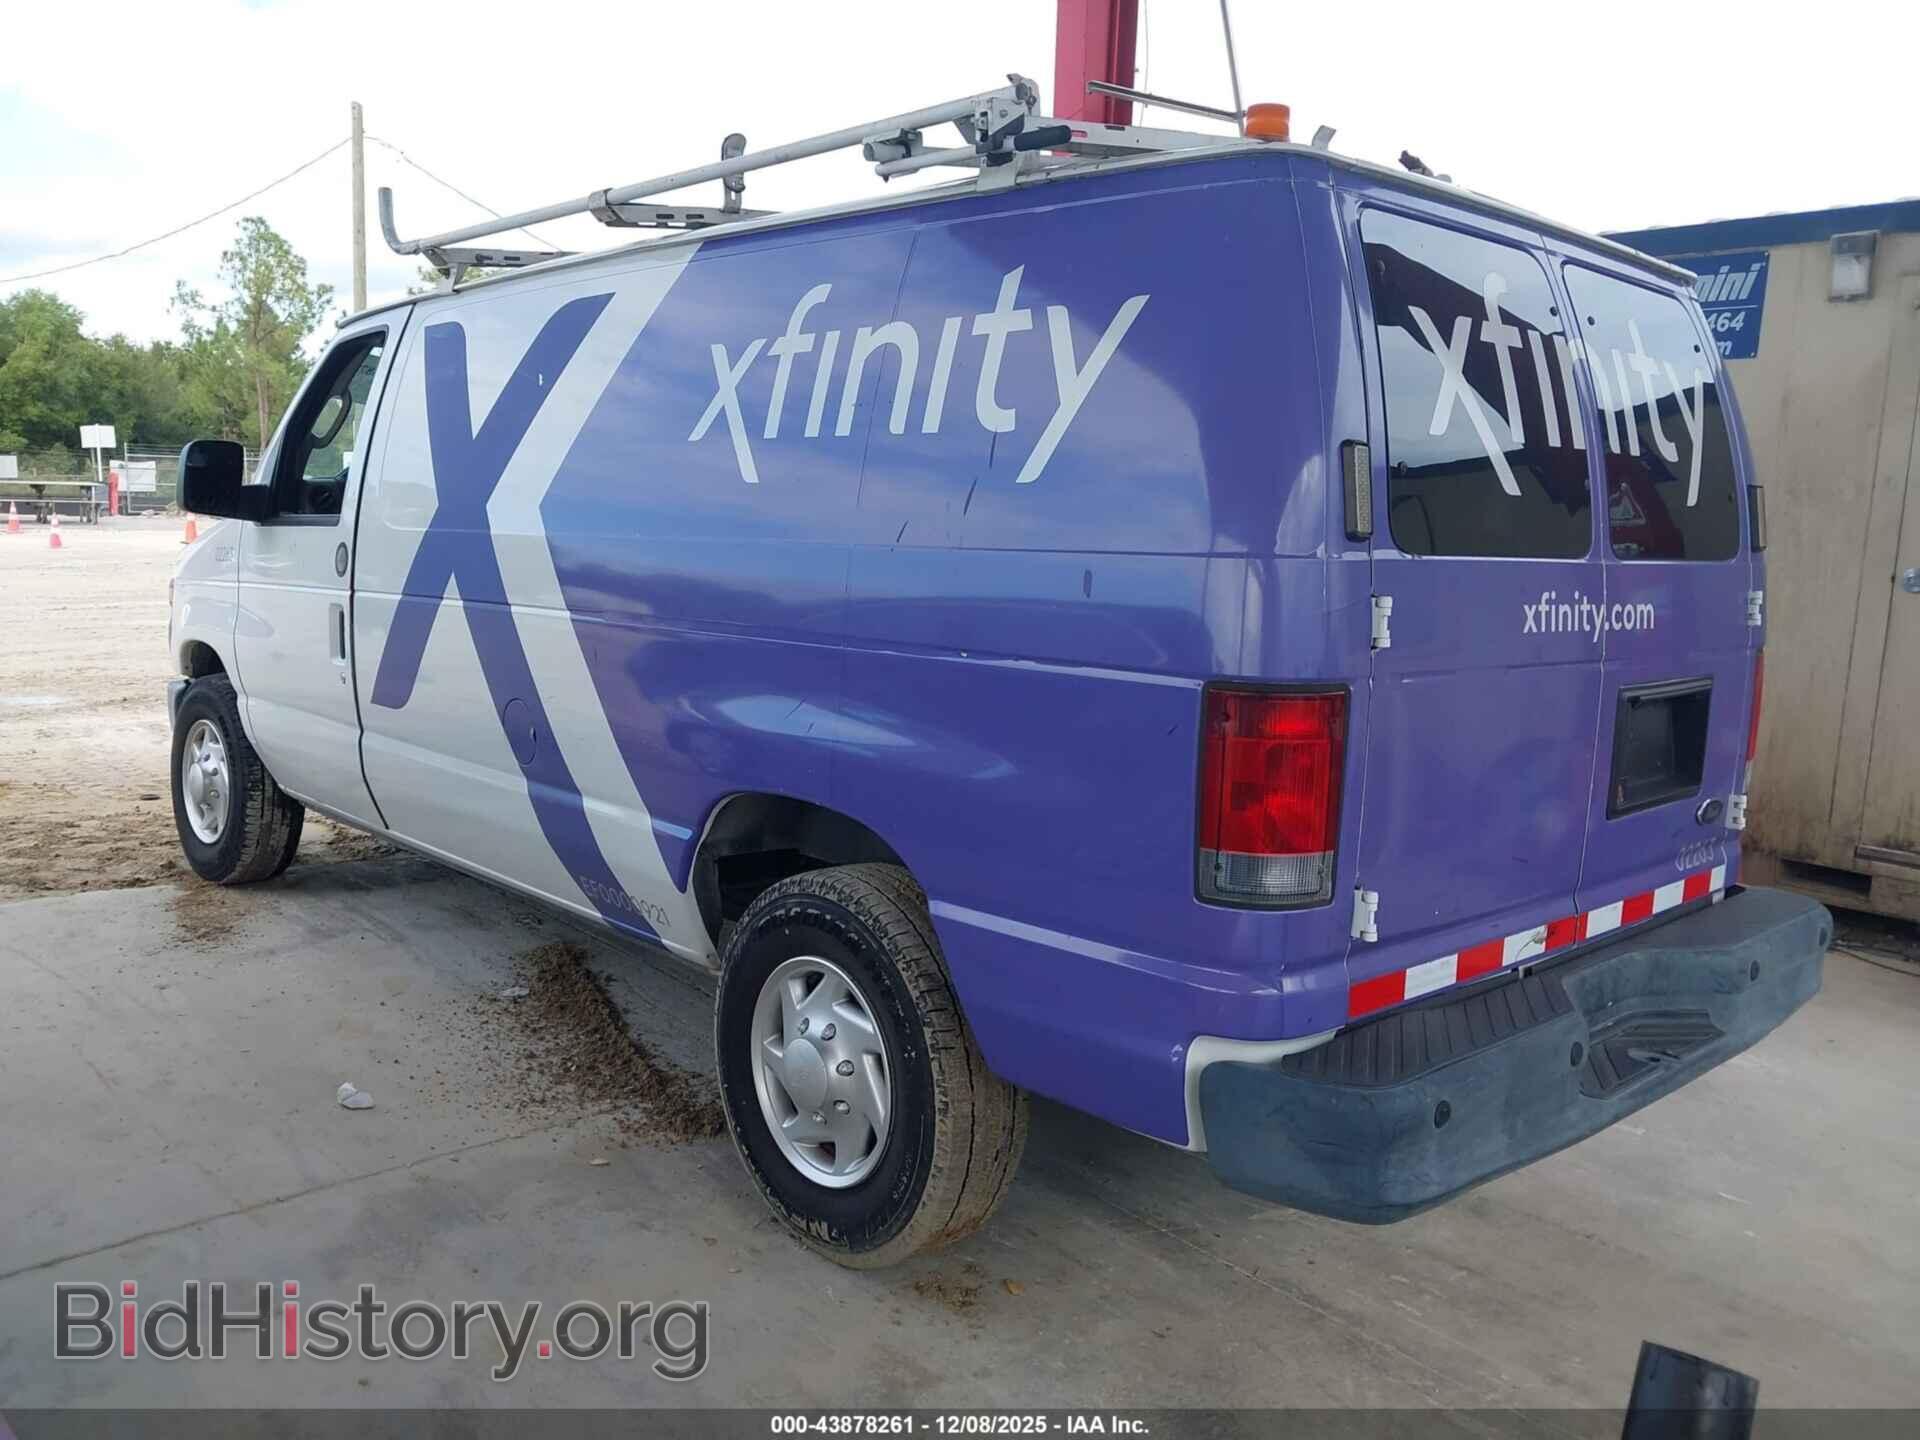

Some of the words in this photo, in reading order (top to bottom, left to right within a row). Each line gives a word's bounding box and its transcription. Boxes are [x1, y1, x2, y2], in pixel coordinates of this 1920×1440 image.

[687, 264, 1151, 484] xfinity
[1408, 272, 1707, 507] xfinity
[1523, 590, 1655, 643] xfinity.com
